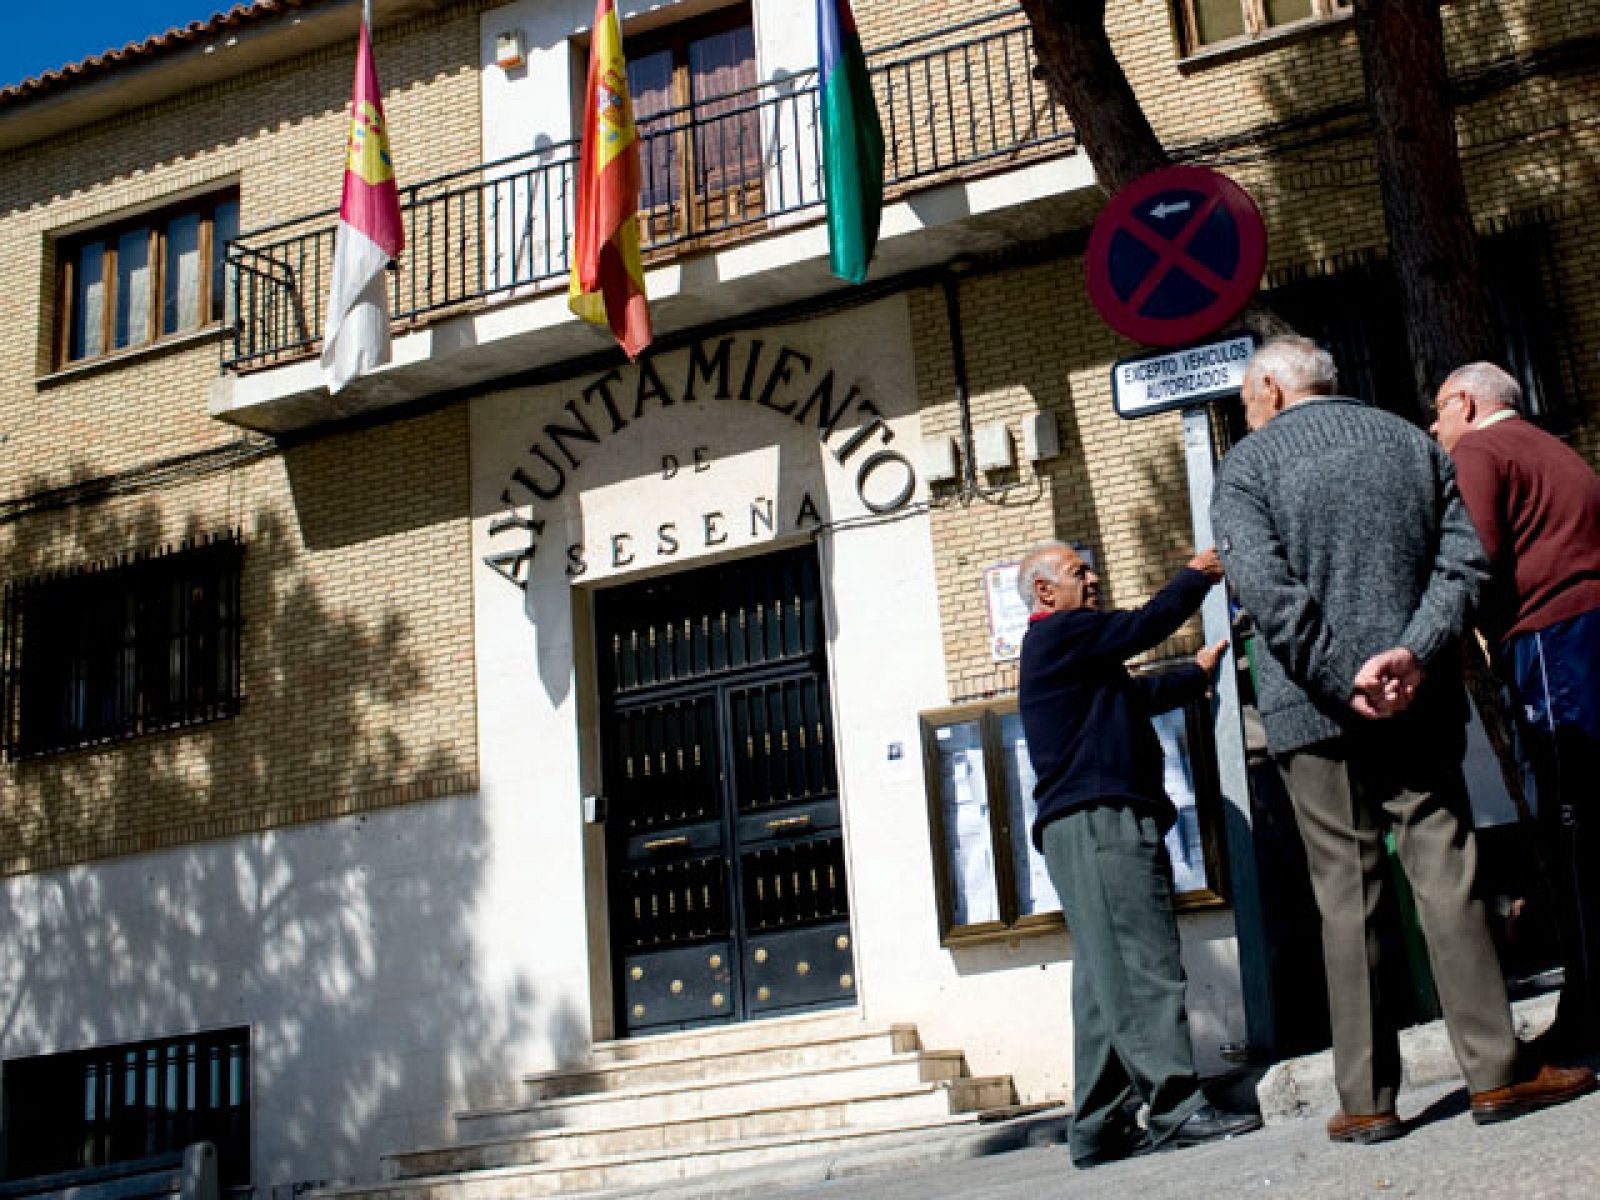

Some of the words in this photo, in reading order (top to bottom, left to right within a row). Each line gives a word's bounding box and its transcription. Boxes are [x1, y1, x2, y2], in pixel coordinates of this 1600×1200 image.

[1124, 358, 1178, 385] EXCEPTO
[1147, 367, 1229, 401] AUTORIZADOS
[484, 337, 916, 590] AYUNTAMIENTO
[662, 446, 711, 481] DE
[565, 492, 823, 577] SESEÑA
